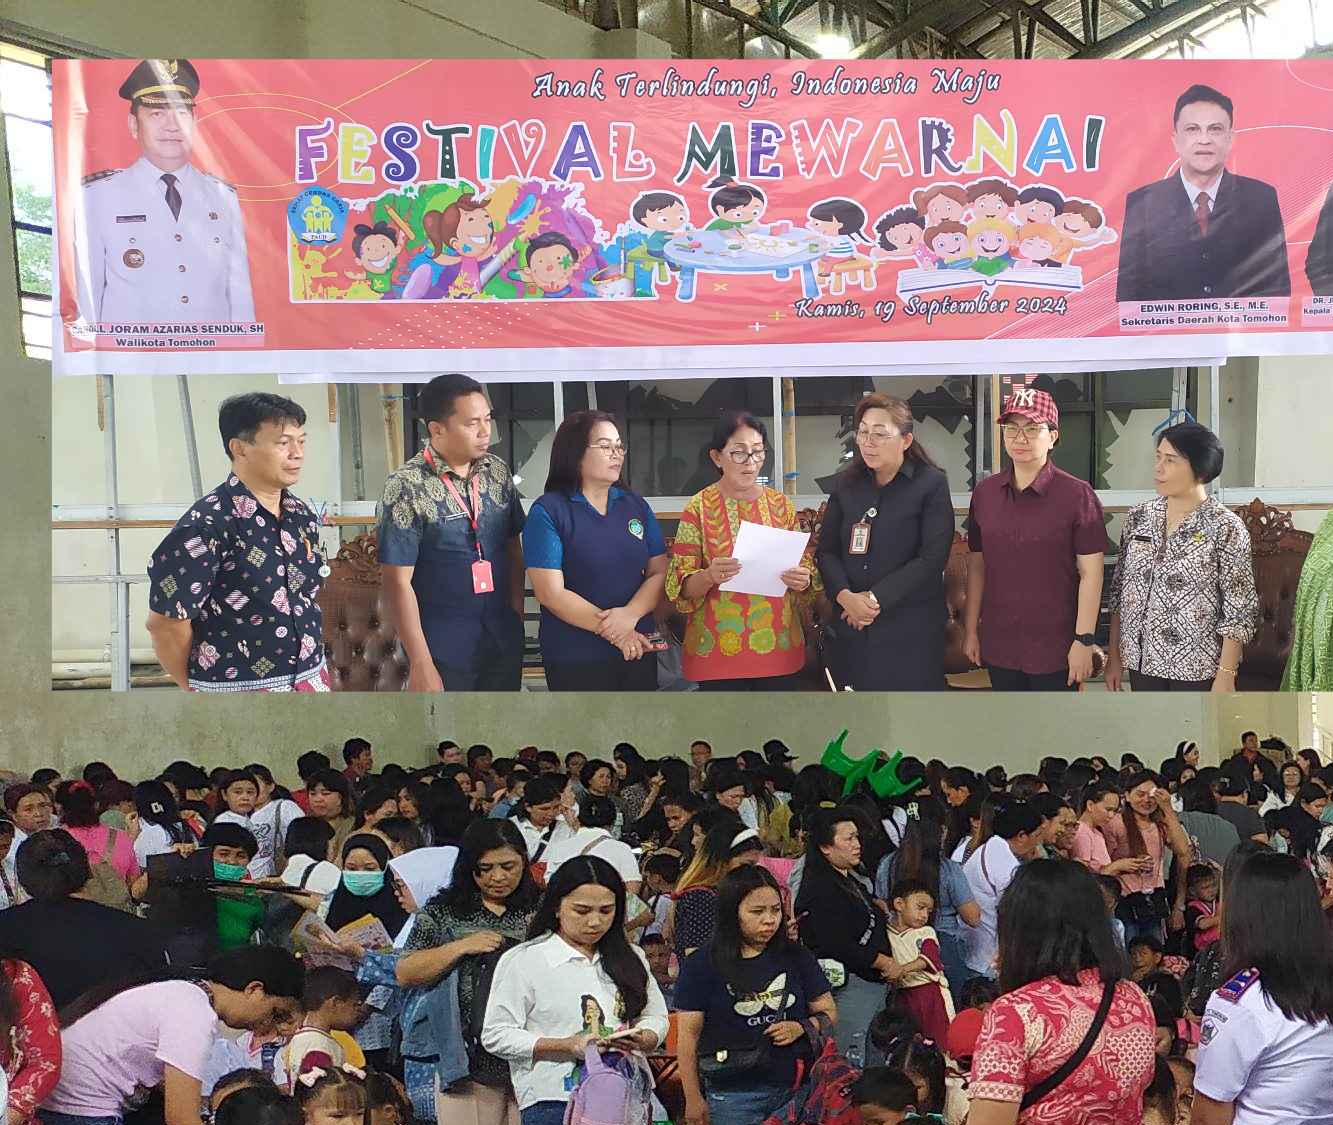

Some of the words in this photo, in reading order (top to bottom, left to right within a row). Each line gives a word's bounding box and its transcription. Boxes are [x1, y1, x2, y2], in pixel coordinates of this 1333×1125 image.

[532, 69, 605, 100] Anak
[615, 67, 778, 107] Terlindungi,
[791, 66, 918, 97] Indonesia
[932, 66, 1001, 103] Maju
[295, 116, 655, 184] FESTIVAL
[674, 108, 1105, 185] MEWARNAI
[795, 298, 865, 319] Kamis,
[873, 300, 895, 321] 19
[903, 292, 1008, 324] September
[1015, 294, 1067, 315] 2024
[1140, 304, 1175, 313] EDWIN
[1248, 301, 1269, 310] M.E.
[1304, 308, 1331, 316] Kepala
[1121, 317, 1175, 326] Sekretaris
[1178, 316, 1214, 324] Daerah
[1217, 314, 1240, 323] Kota
[1242, 314, 1287, 322] Tomohon
[109, 325, 150, 334] JORAM
[153, 325, 198, 334] AZARIAS
[201, 325, 247, 334] SENDUK,
[250, 324, 264, 333] SH
[116, 338, 166, 347] Walikota
[168, 337, 216, 347] Tomohon
